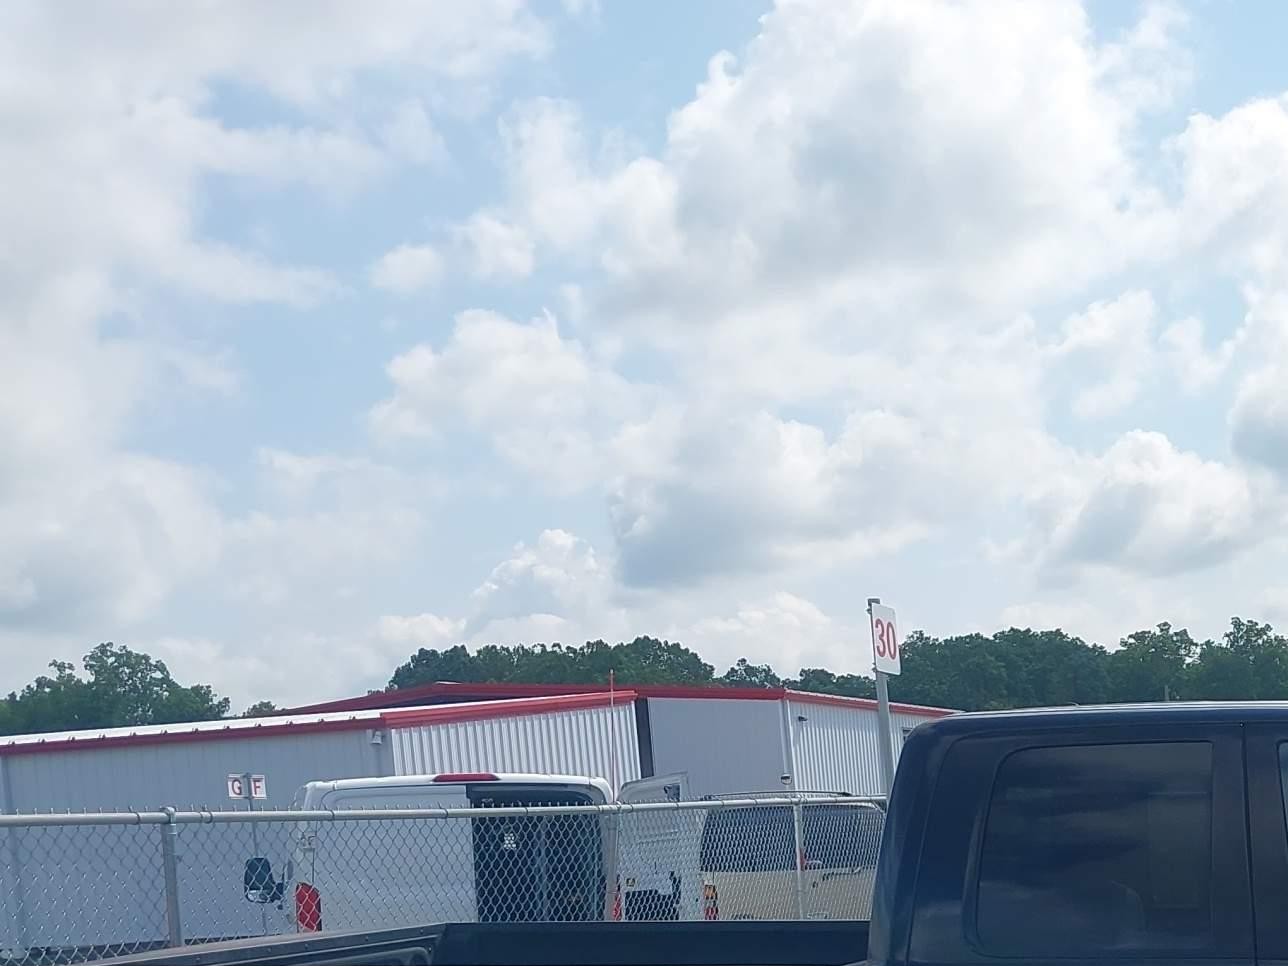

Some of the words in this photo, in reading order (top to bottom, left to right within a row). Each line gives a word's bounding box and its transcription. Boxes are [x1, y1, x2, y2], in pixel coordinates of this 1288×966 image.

[875, 617, 898, 661] 30
[231, 778, 243, 796] G
[252, 779, 262, 796] F
